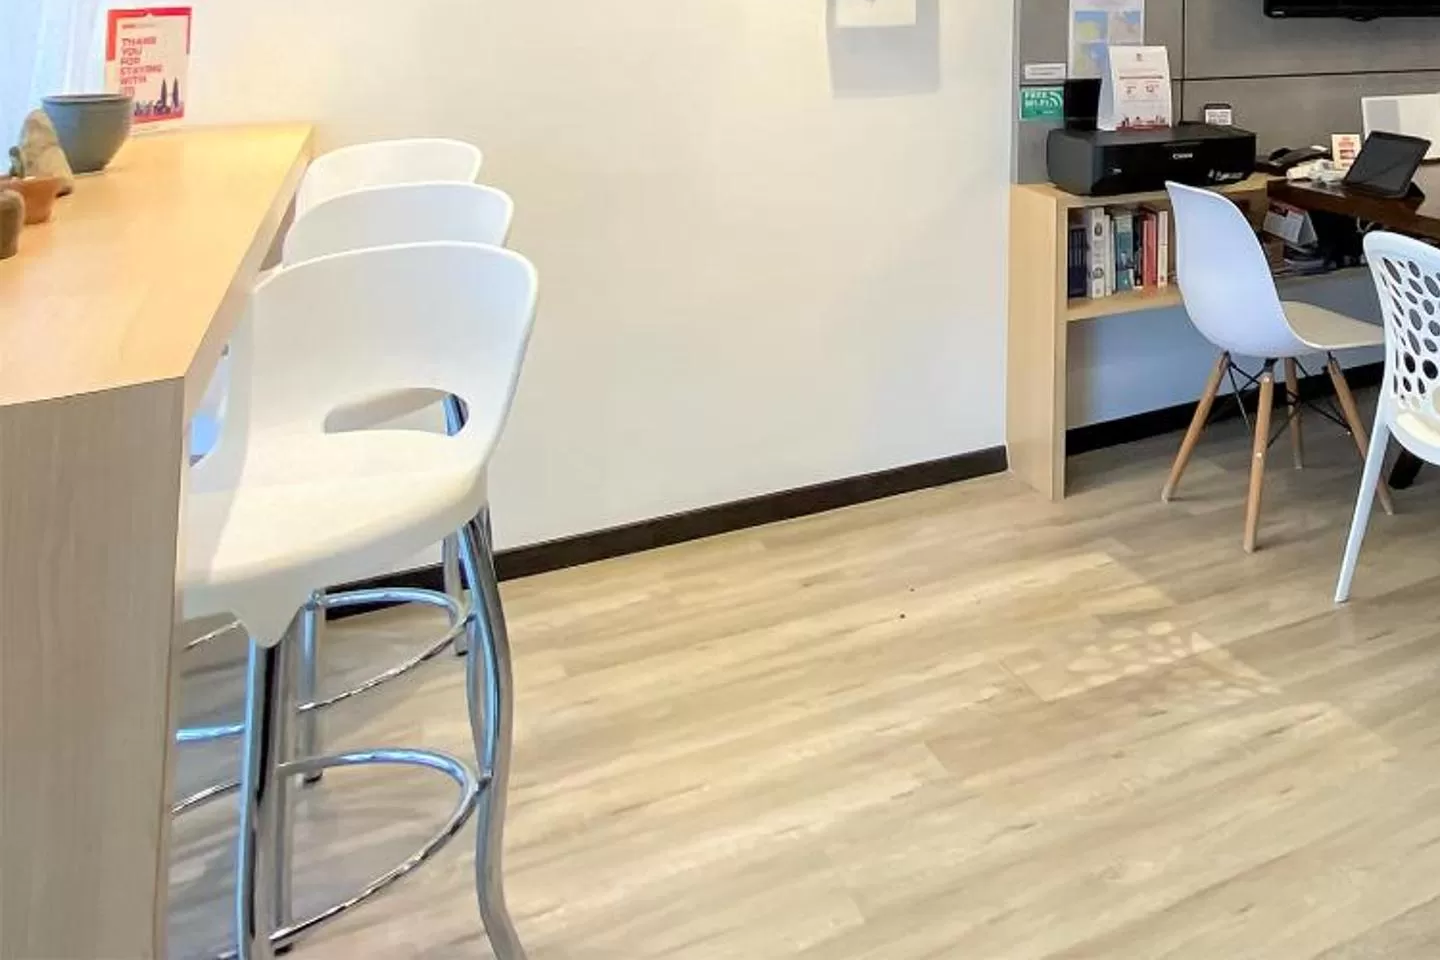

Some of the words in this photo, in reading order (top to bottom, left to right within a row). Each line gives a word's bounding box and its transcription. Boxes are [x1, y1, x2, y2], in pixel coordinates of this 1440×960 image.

[121, 36, 157, 46] THANK
[121, 47, 143, 57] YOU
[120, 57, 141, 66] FOR
[120, 75, 147, 85] WITH
